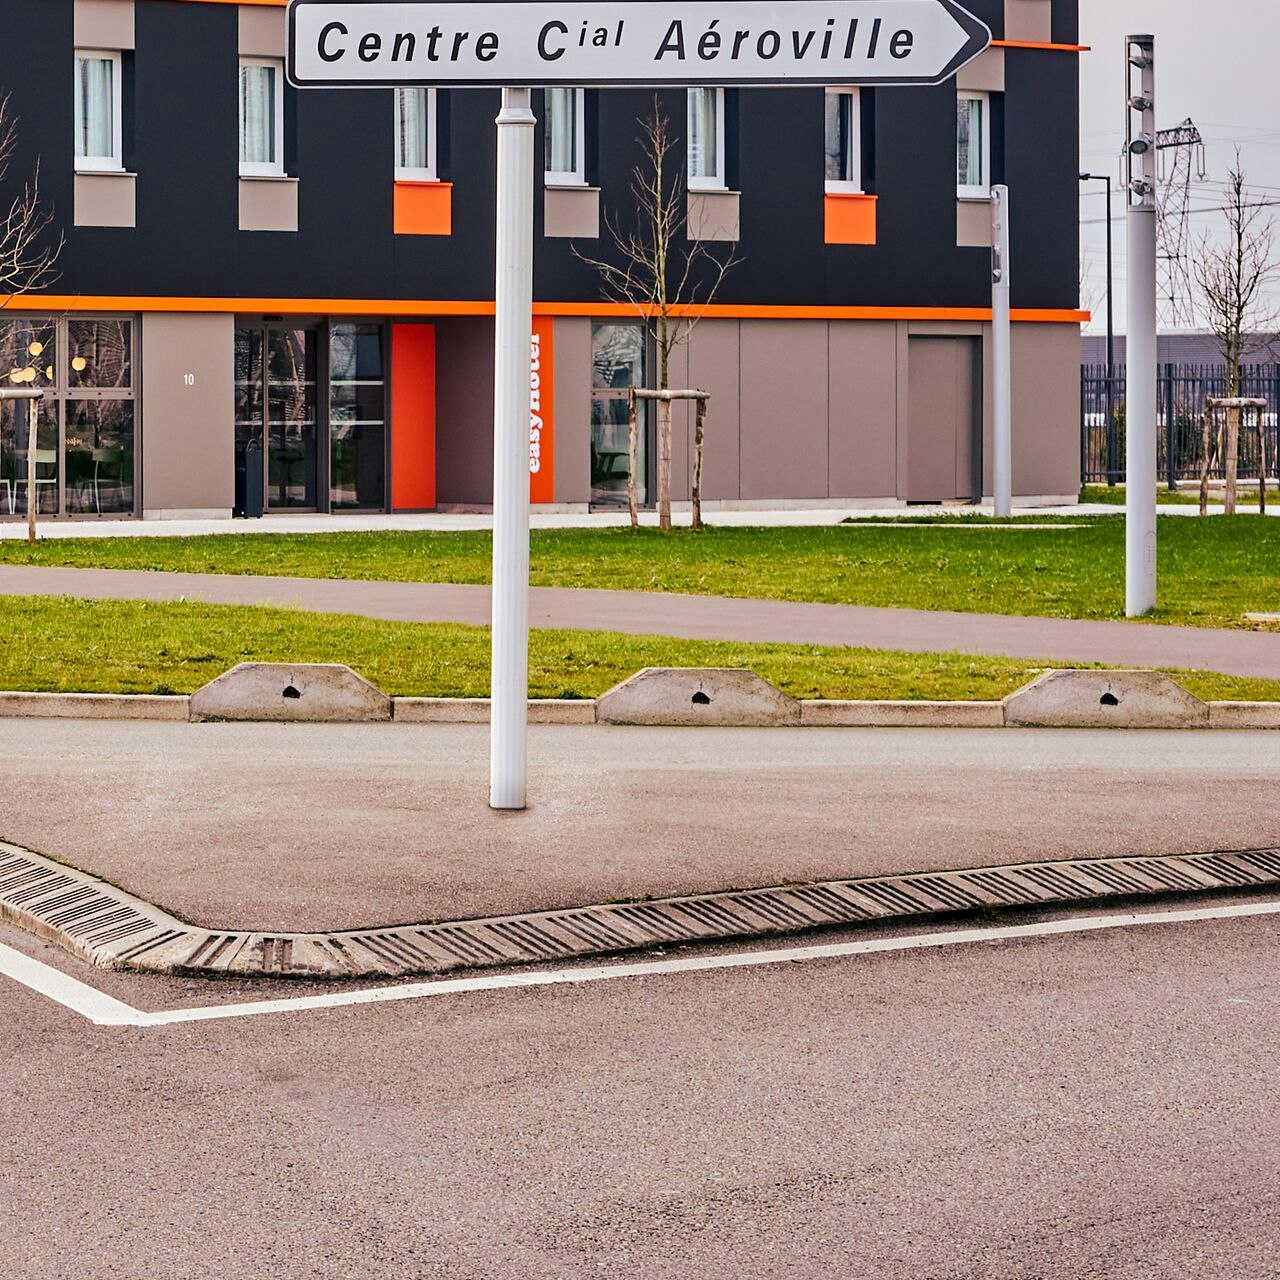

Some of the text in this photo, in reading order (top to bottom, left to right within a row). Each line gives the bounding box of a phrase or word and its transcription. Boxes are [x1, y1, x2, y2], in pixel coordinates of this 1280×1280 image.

[317, 21, 499, 63] Centre
[653, 17, 914, 61] Aéroville
[183, 373, 195, 386] 10
